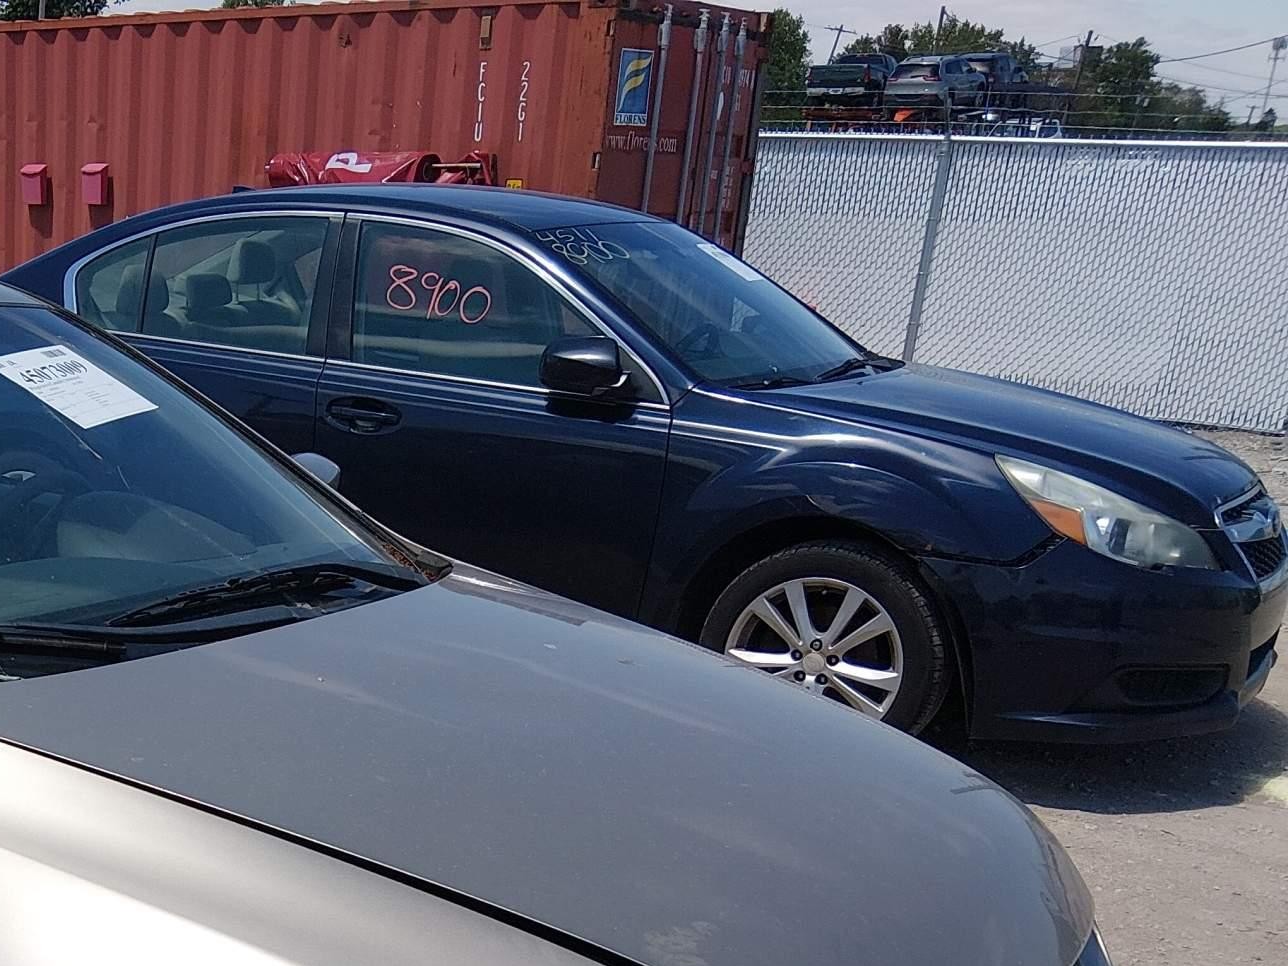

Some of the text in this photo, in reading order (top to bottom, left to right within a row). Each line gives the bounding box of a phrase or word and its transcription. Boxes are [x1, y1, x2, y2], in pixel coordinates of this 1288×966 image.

[474, 61, 488, 141] FCIU
[615, 114, 646, 124] FLORENS
[386, 264, 492, 323] 8900
[19, 359, 88, 385] 45073009
